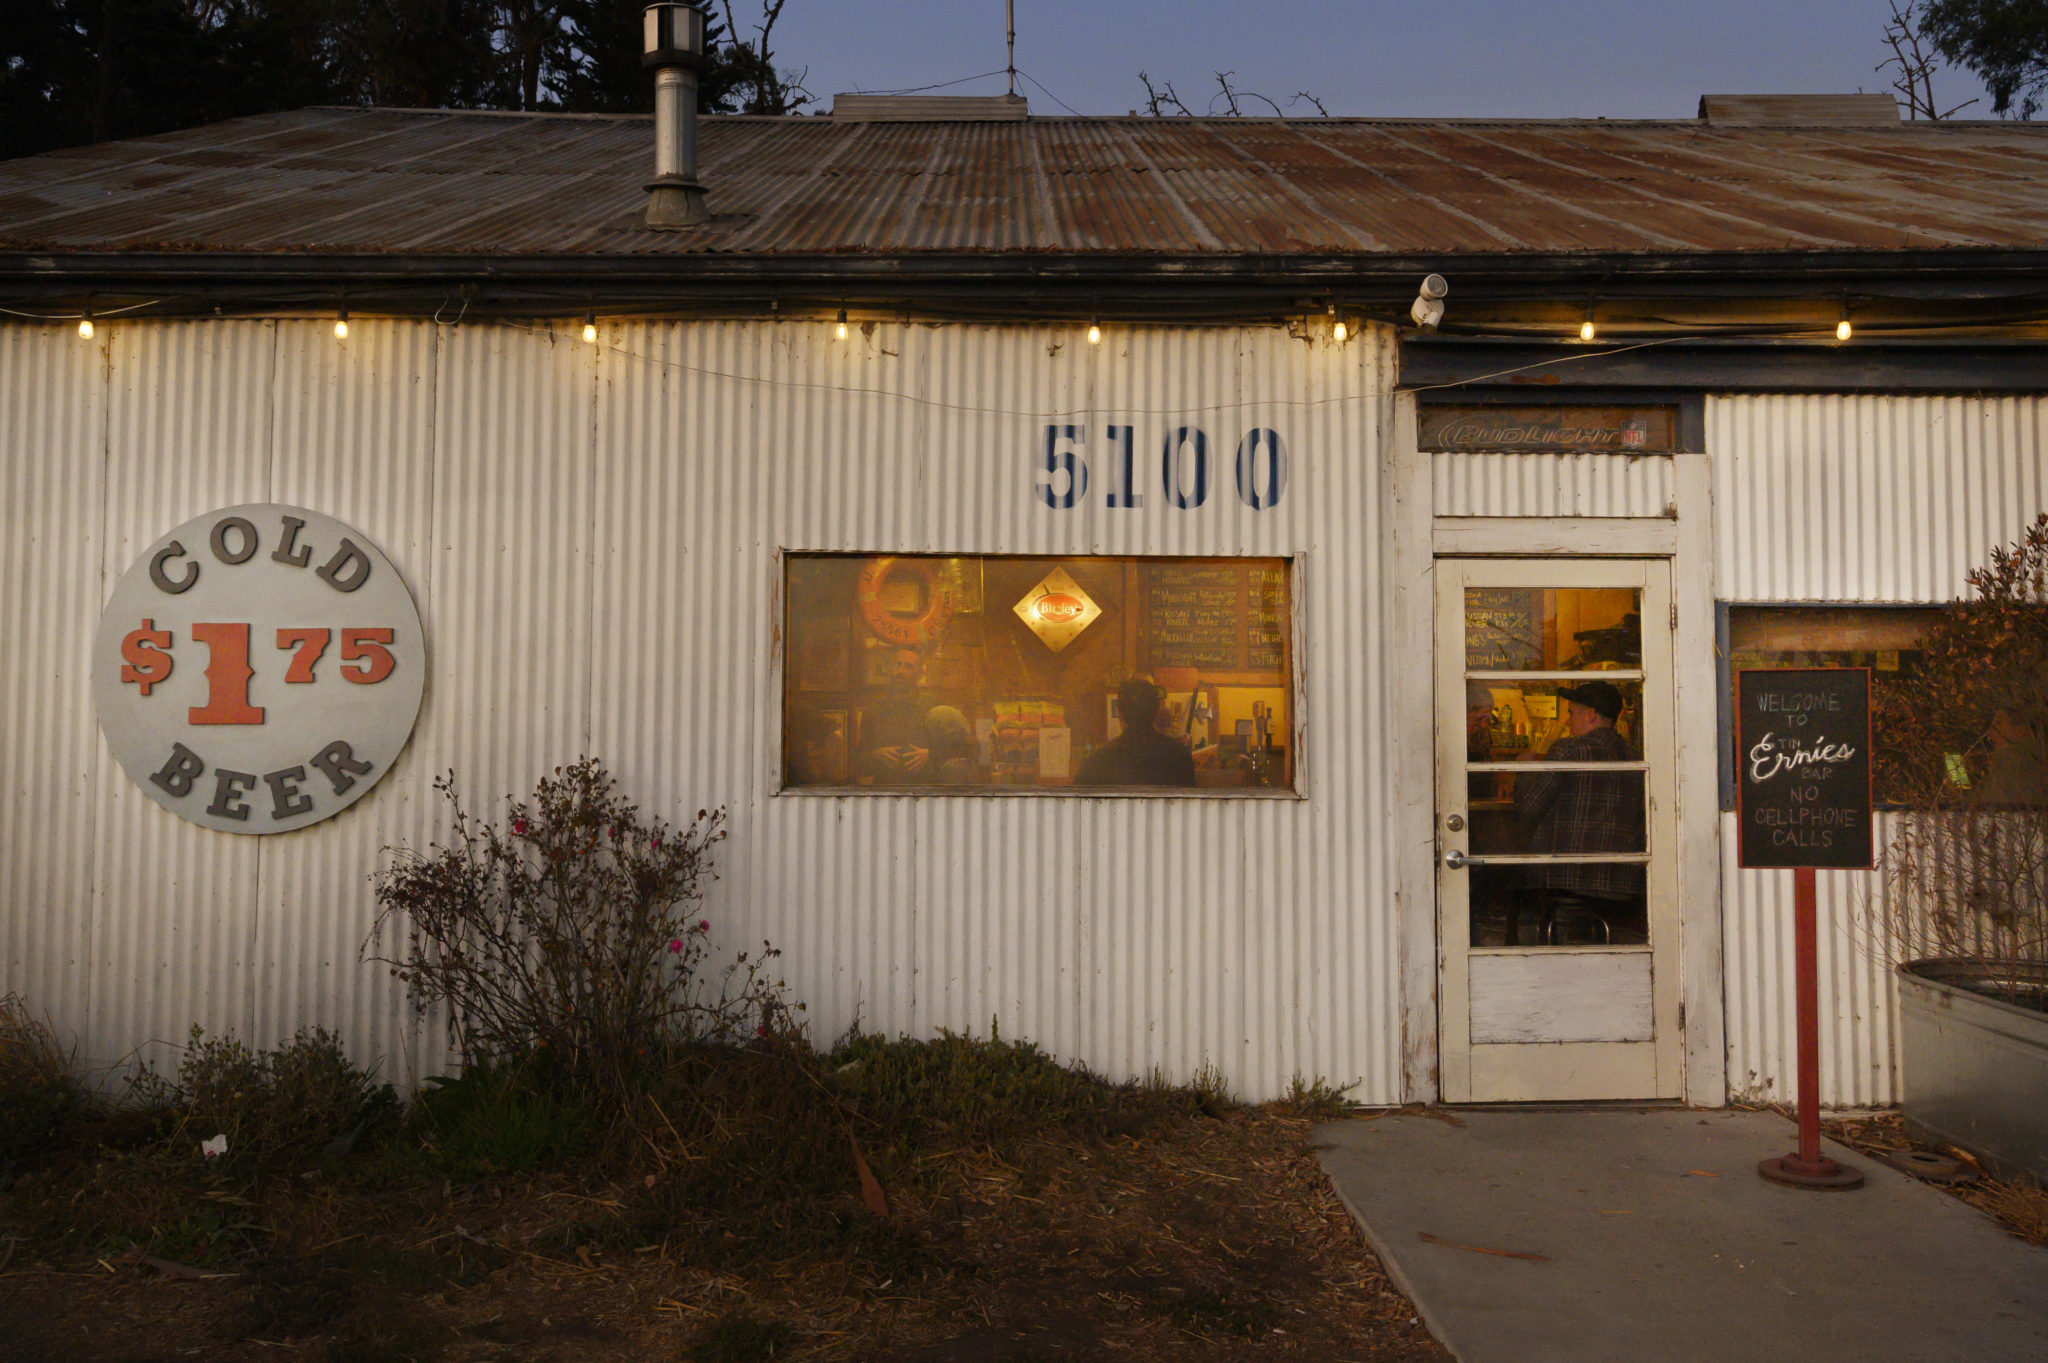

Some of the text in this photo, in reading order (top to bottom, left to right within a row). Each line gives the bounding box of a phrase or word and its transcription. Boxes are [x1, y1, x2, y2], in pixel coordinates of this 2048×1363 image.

[1623, 430, 1644, 444] NFL
[1035, 424, 1288, 510] 5100
[149, 515, 371, 595] COLD
[1757, 693, 1841, 712] WELCOME
[1786, 714, 1808, 728] TO
[1778, 738, 1801, 750] TIN
[149, 739, 374, 821] BEER
[1801, 766, 1833, 780] BAR
[1790, 785, 1819, 803] NO
[1755, 807, 1859, 828] CELLPHONE
[1773, 828, 1833, 848] CALLS
